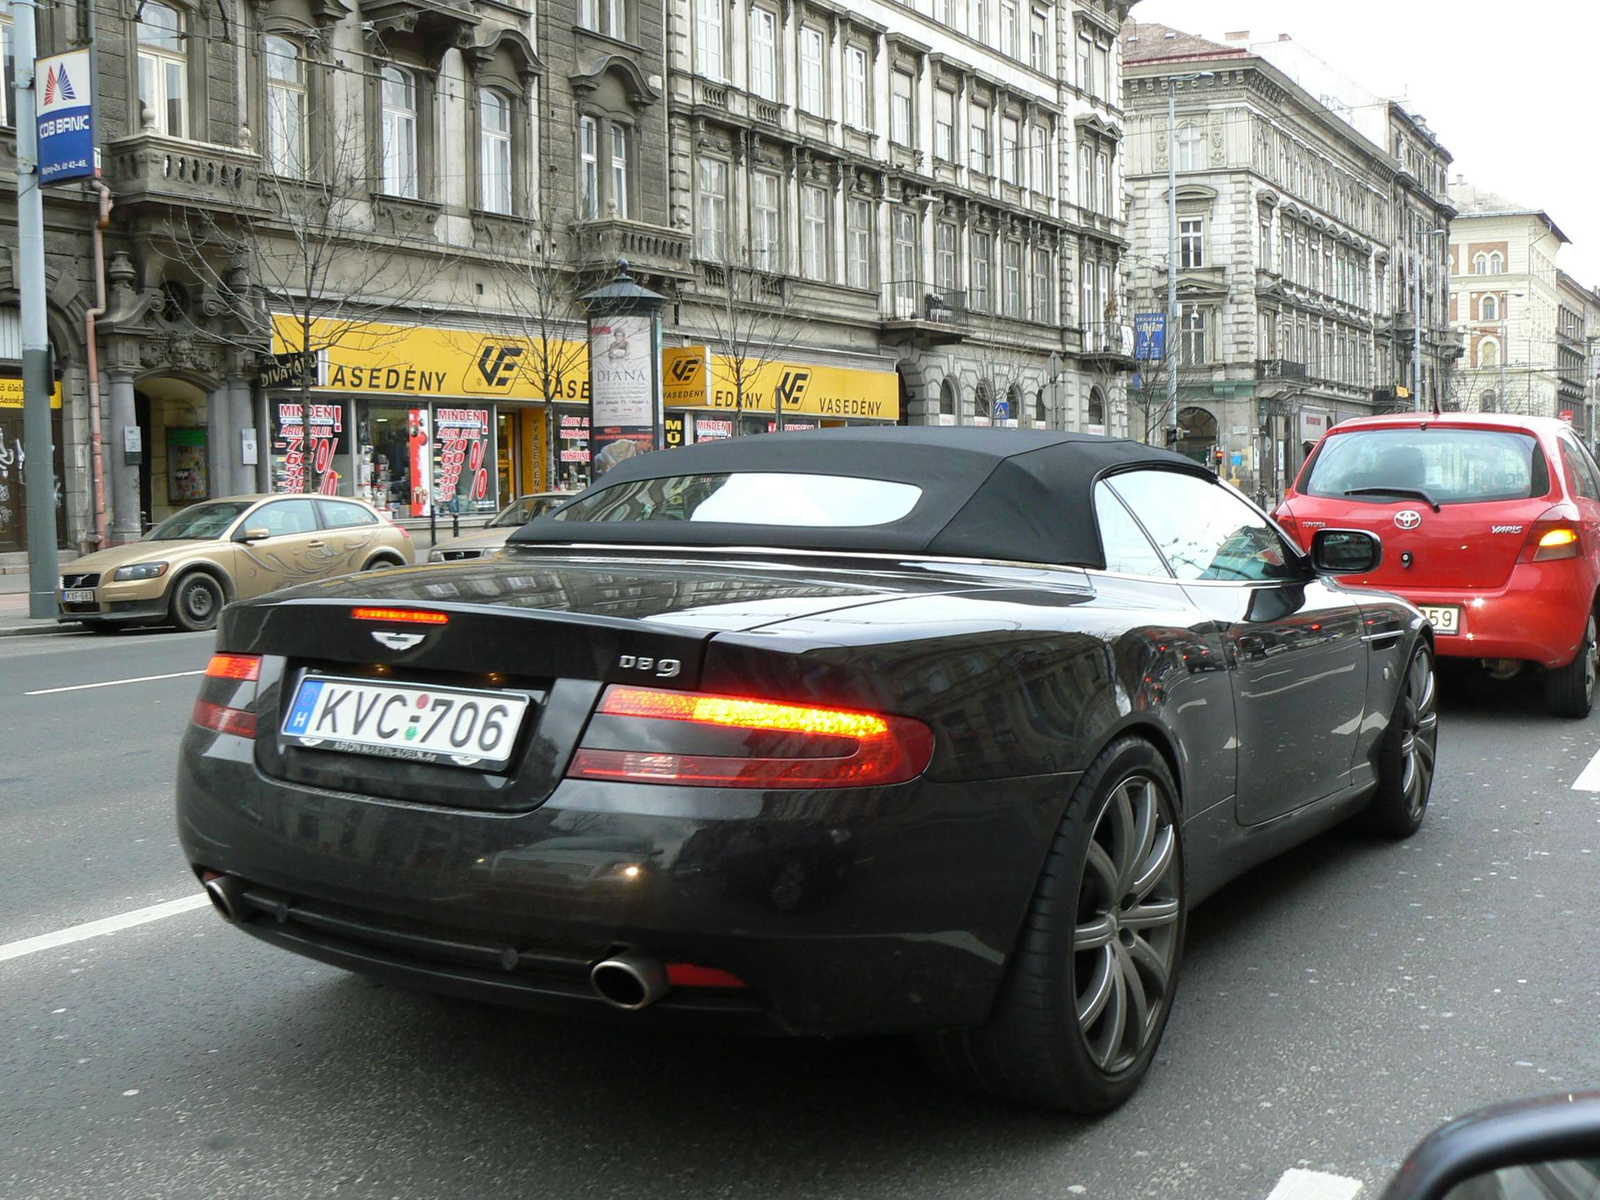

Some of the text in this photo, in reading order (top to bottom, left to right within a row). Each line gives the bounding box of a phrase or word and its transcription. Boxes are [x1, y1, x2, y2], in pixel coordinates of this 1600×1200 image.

[56, 114, 90, 134] BANK
[328, 362, 448, 393] ASEDÉNY
[597, 370, 646, 382] DIANA
[819, 397, 882, 416] VASEDÉNY
[437, 409, 481, 422] MINDEN
[697, 420, 727, 431] MINDEN
[433, 438, 468, 452] -70
[1491, 525, 1523, 534] YARIS
[293, 711, 305, 728] H
